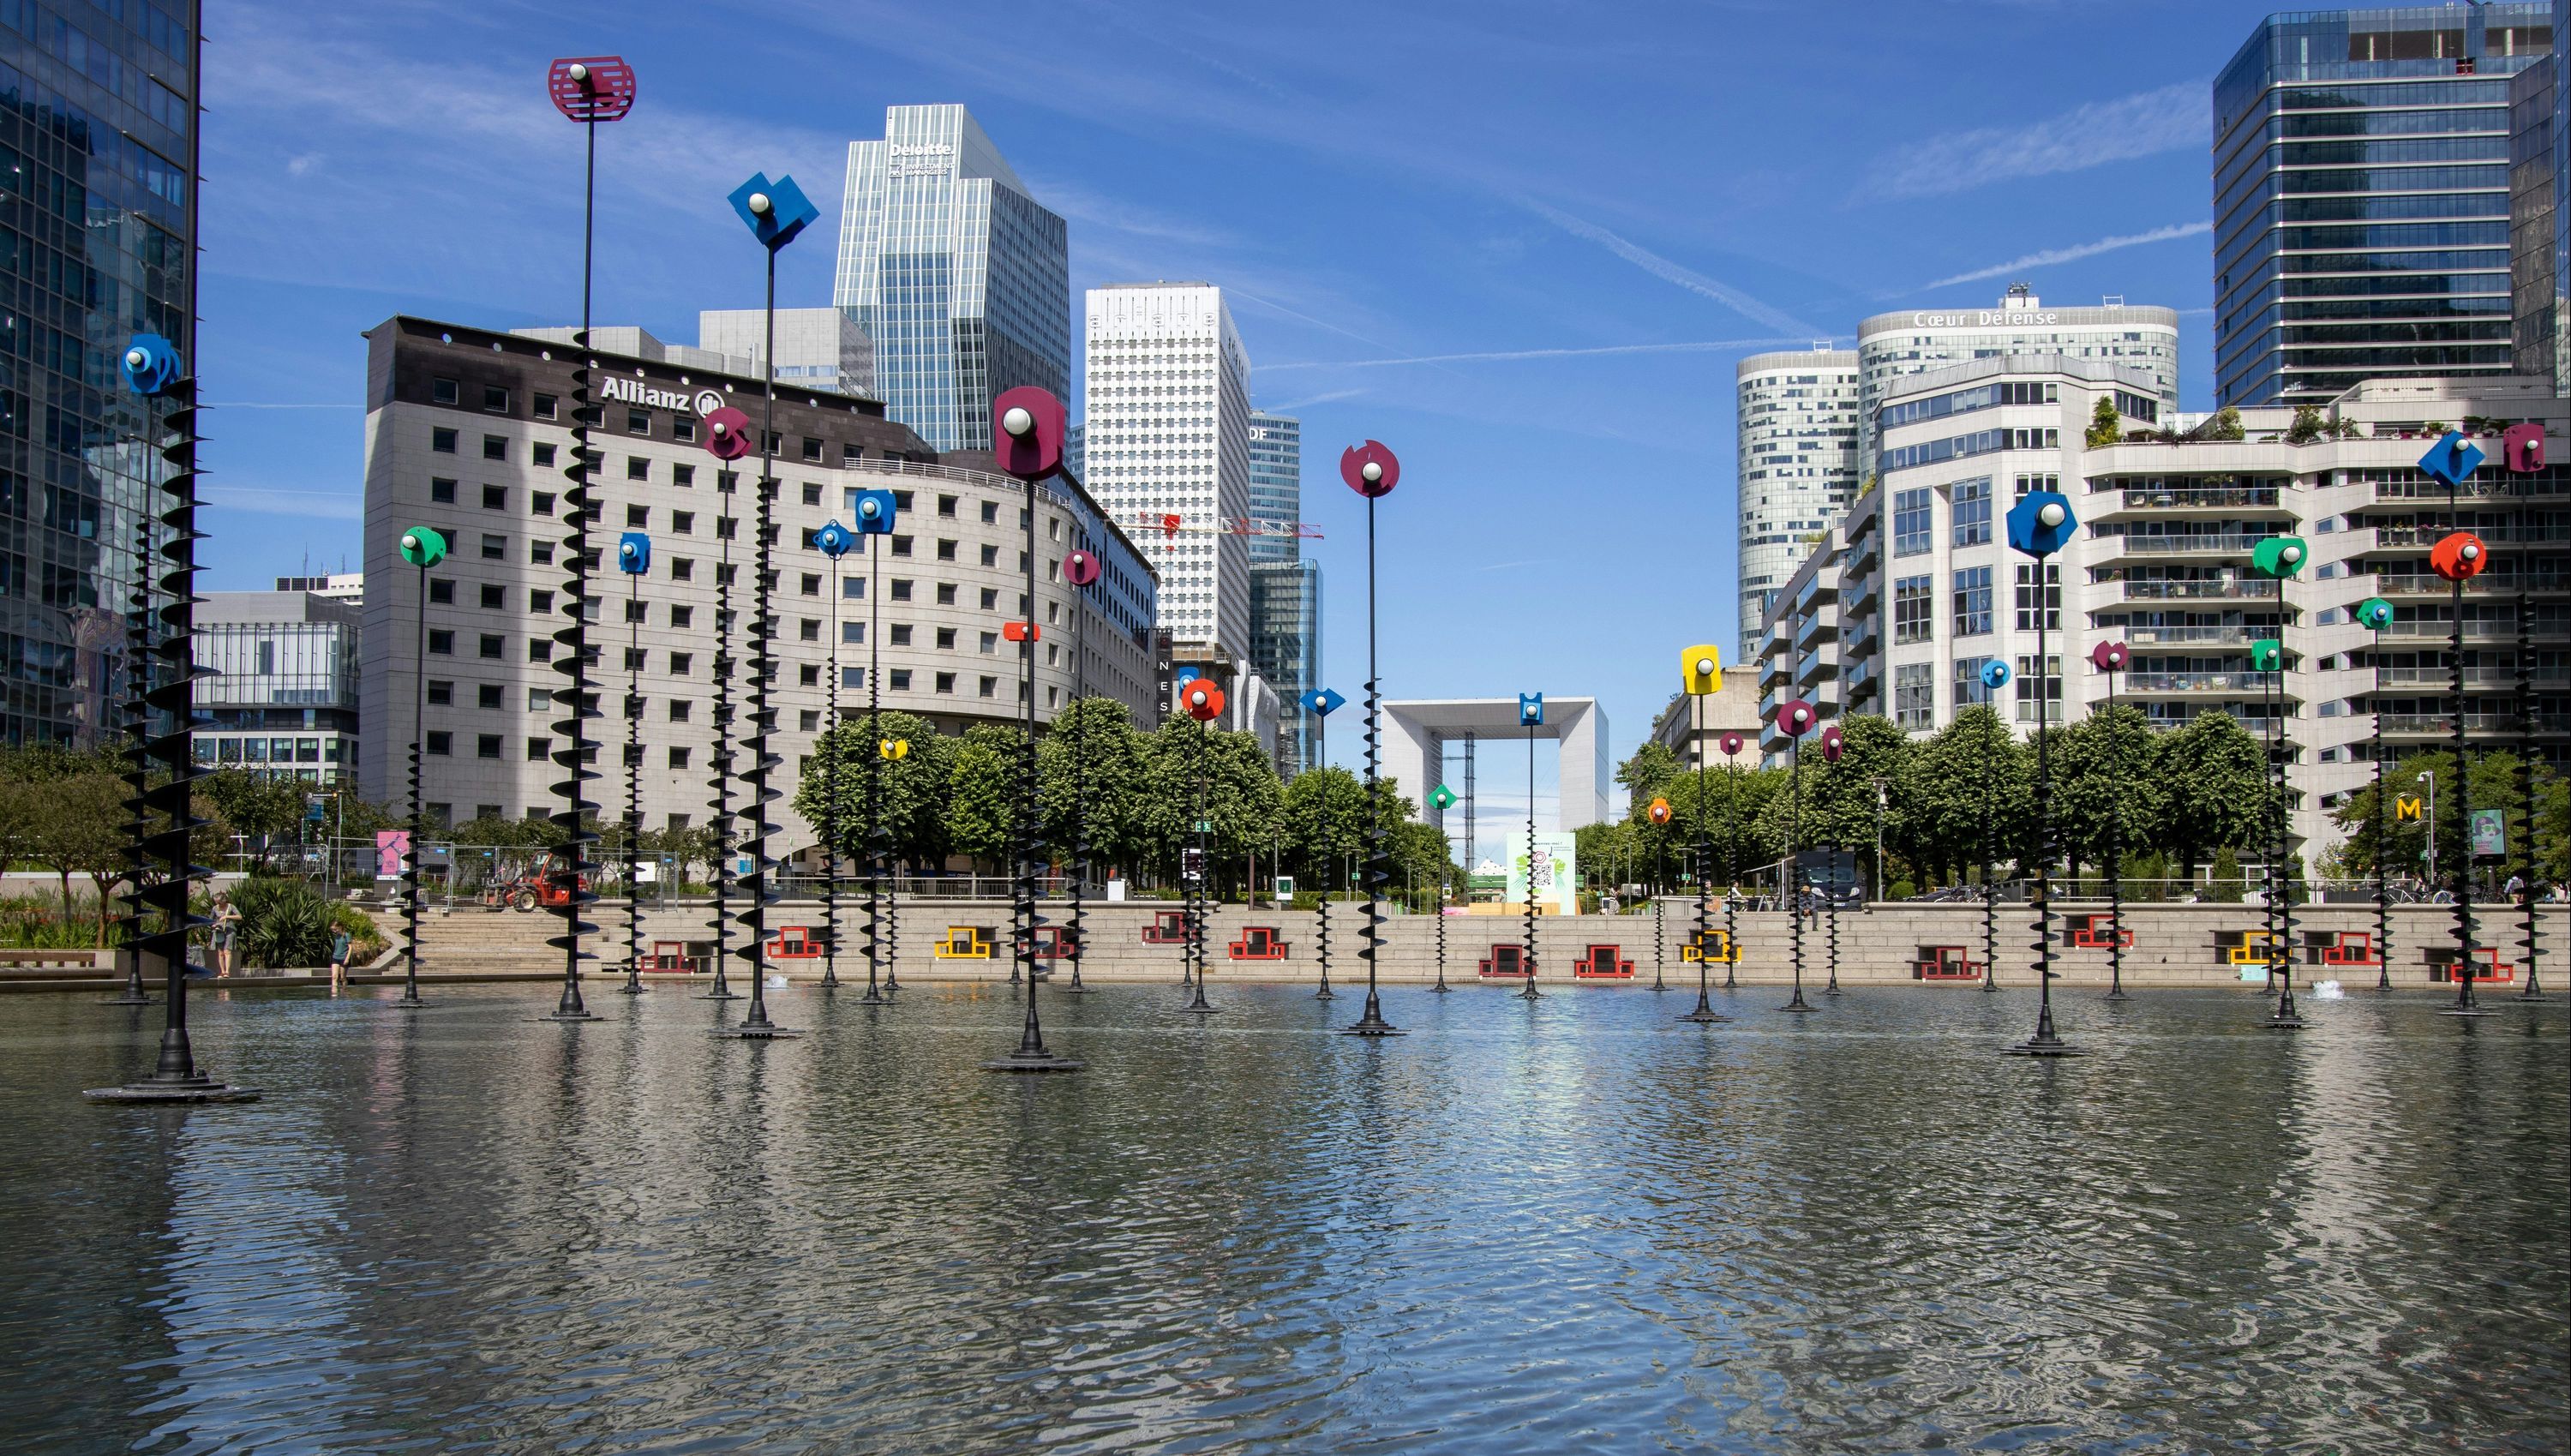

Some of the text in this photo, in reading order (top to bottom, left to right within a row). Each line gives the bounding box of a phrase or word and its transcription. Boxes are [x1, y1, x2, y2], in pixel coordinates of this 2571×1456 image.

[891, 143, 954, 157] Deloitte.
[1979, 309, 2057, 326] Défense
[601, 376, 690, 411] Allianz
[2396, 797, 2420, 820] M
